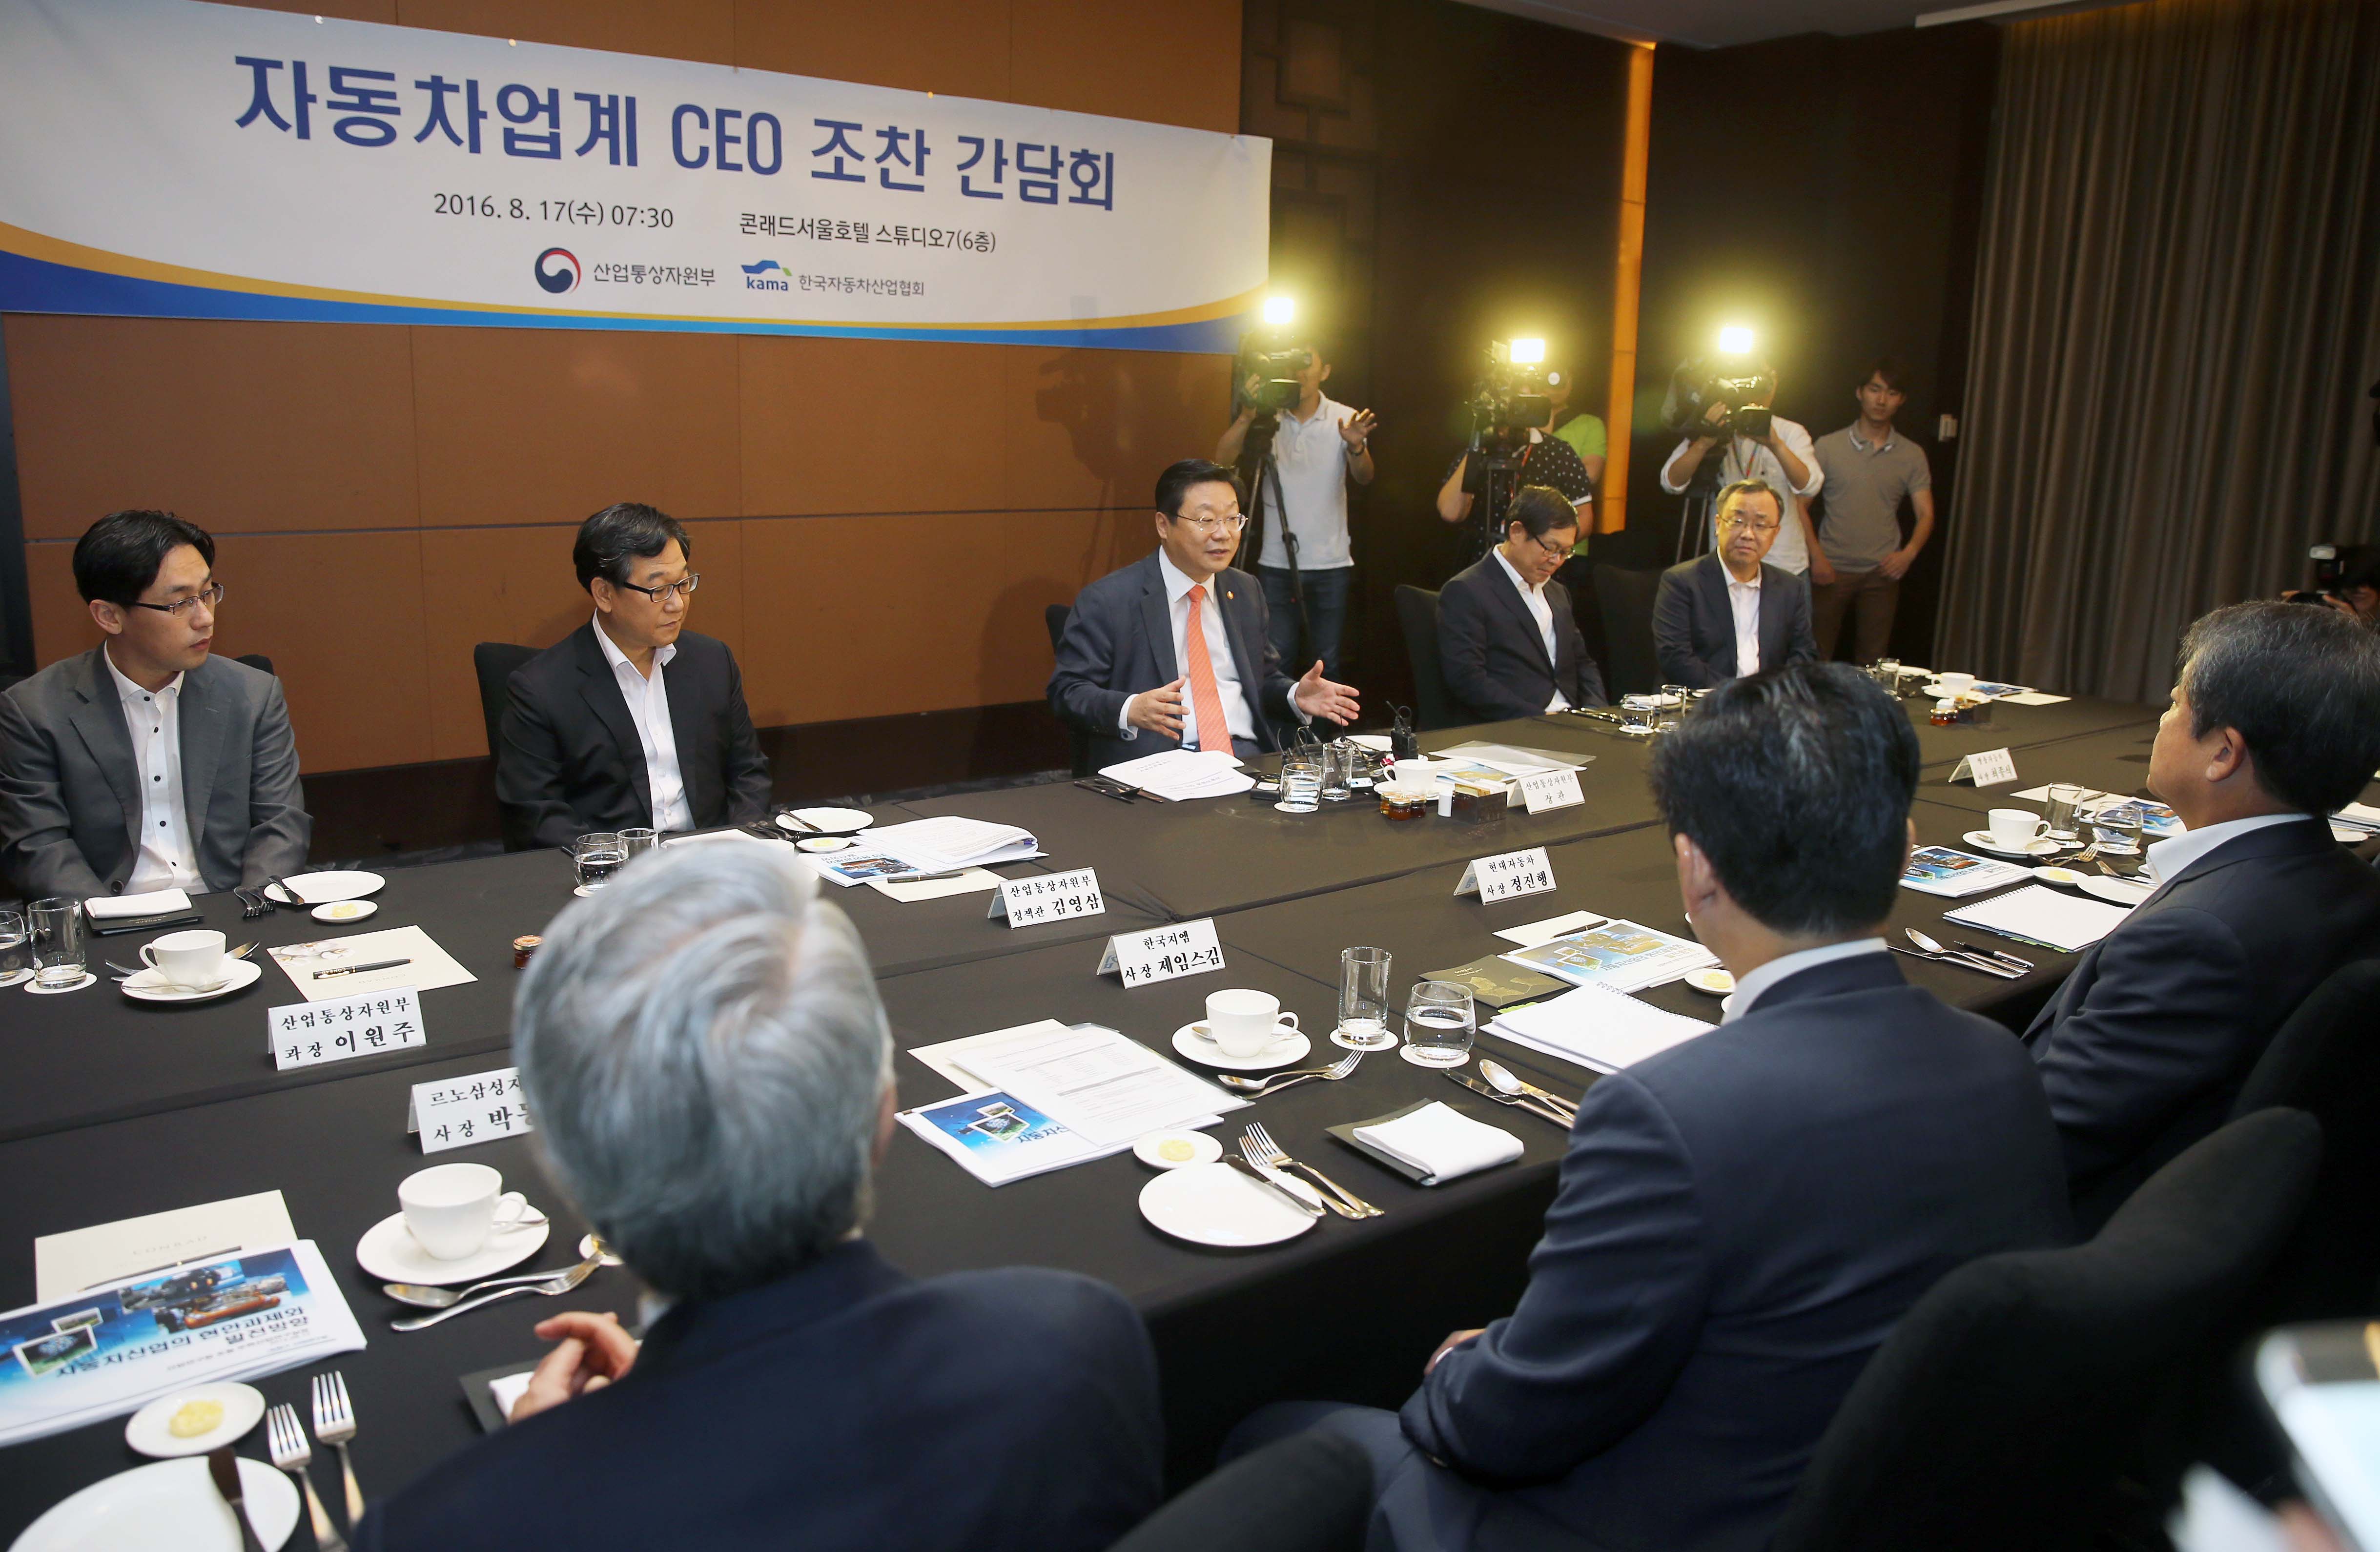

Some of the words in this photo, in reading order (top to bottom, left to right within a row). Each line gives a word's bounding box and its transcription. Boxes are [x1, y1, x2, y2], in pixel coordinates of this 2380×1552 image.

[235, 56, 638, 167] 자동차업계
[672, 103, 782, 176] CEO
[811, 118, 931, 193] 조찬
[956, 135, 1114, 211] 간담회
[434, 193, 501, 218] 2016.
[510, 198, 530, 220] 8.
[540, 200, 603, 226] 17(수)
[612, 205, 673, 228] 07:30
[739, 213, 869, 244] 콘래드서울호텔
[876, 225, 996, 253] 스튜디오7(6층)
[594, 263, 715, 286] 산업통상자원부
[745, 276, 789, 292] kama
[799, 274, 924, 297] 한국자동차산업협회
[1526, 774, 1574, 791] 산업통상자원부
[1545, 790, 1565, 804] 장관
[1488, 855, 1534, 872] 현대자동차
[1010, 875, 1091, 897] 산업통상자원부
[1487, 883, 1505, 896] 사장
[1511, 871, 1548, 891] 정진행
[1012, 905, 1045, 921] 정책관
[1052, 893, 1099, 915] 김영삼
[1143, 930, 1190, 950] 한국지엠
[1125, 963, 1151, 981] 사장
[1157, 946, 1220, 974] 제임스김
[281, 997, 410, 1030] 산업통상자원부
[285, 1041, 323, 1061] 과장
[335, 1021, 415, 1052] 이원주
[434, 1120, 475, 1142] 사장
